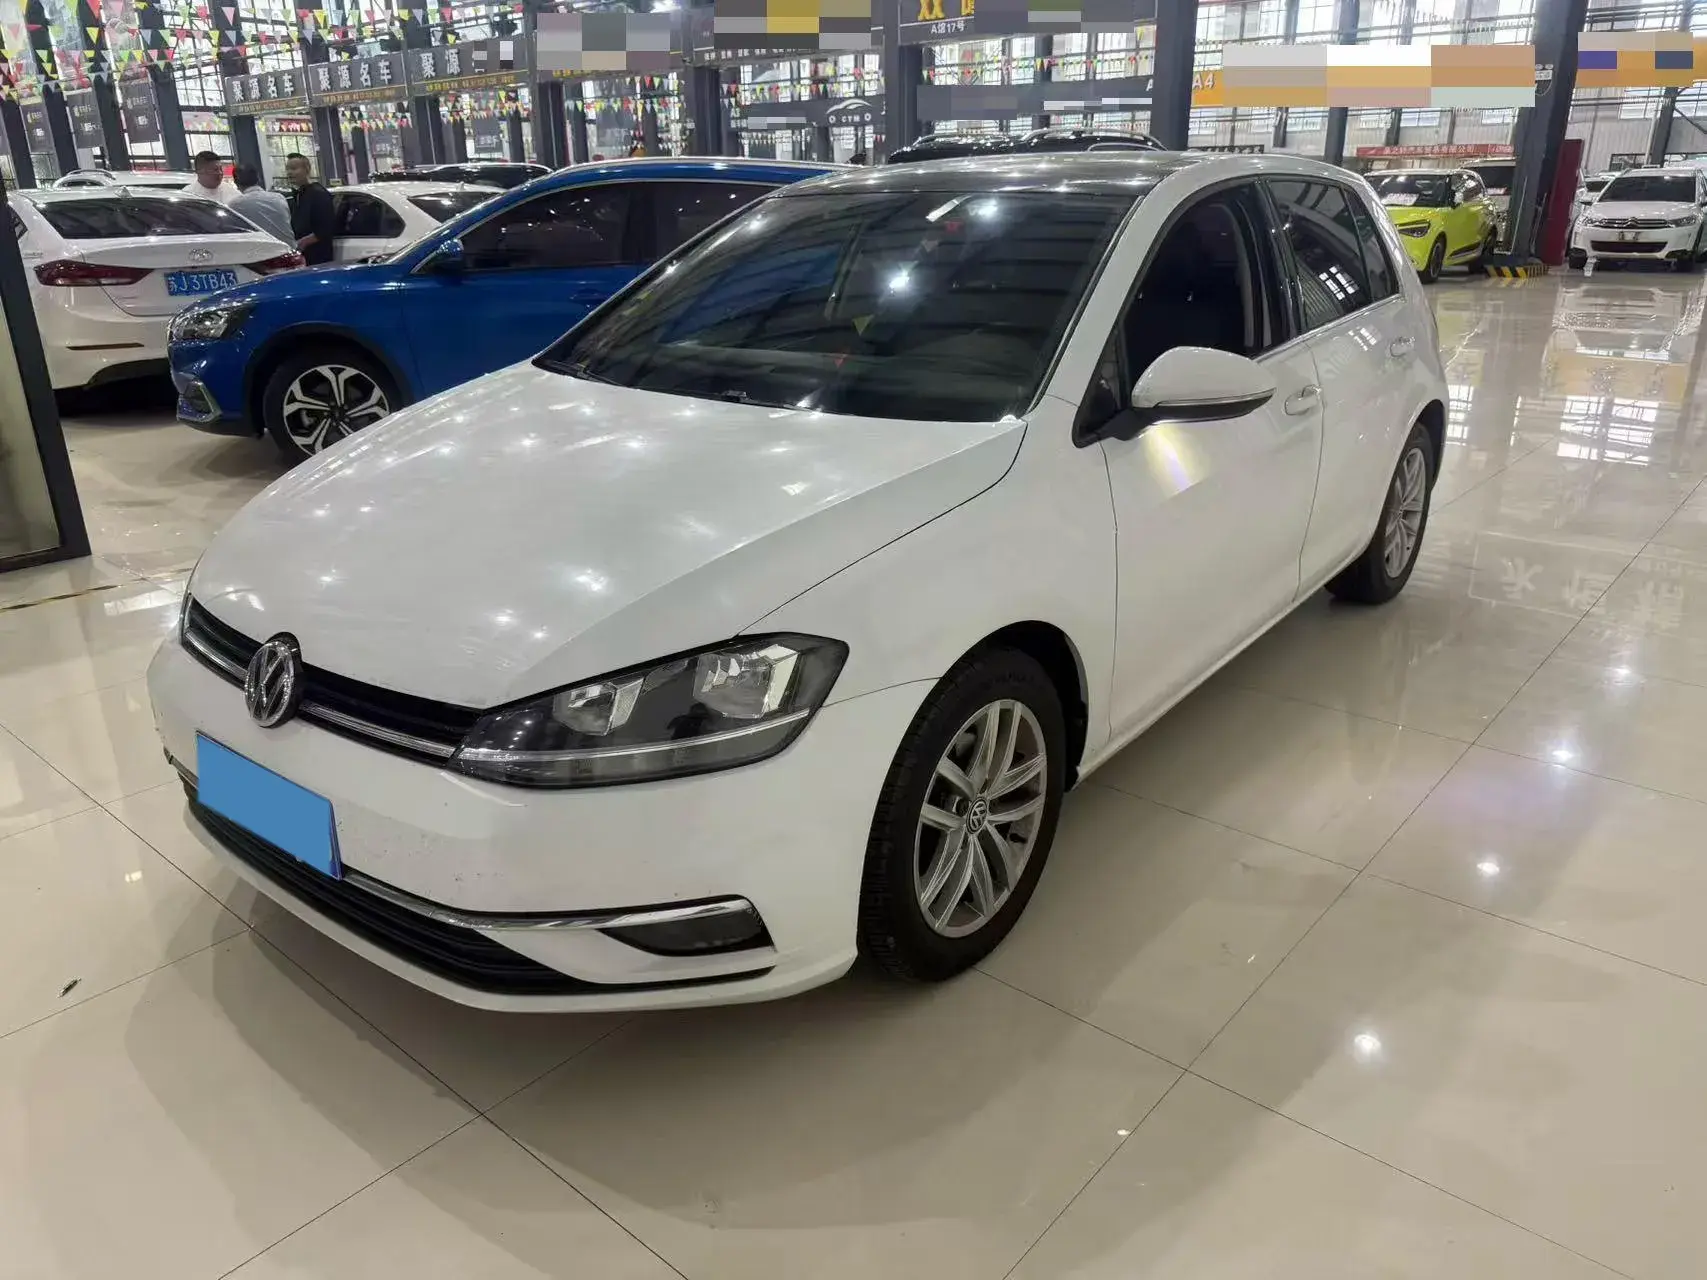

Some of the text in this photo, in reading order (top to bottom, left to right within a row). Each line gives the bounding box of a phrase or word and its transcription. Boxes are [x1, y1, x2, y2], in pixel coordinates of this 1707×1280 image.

[232, 73, 295, 102] 聚源名车
[317, 59, 392, 91] 聚源名车
[1192, 72, 1215, 90] A4
[168, 271, 237, 292] 苏J3TB43
